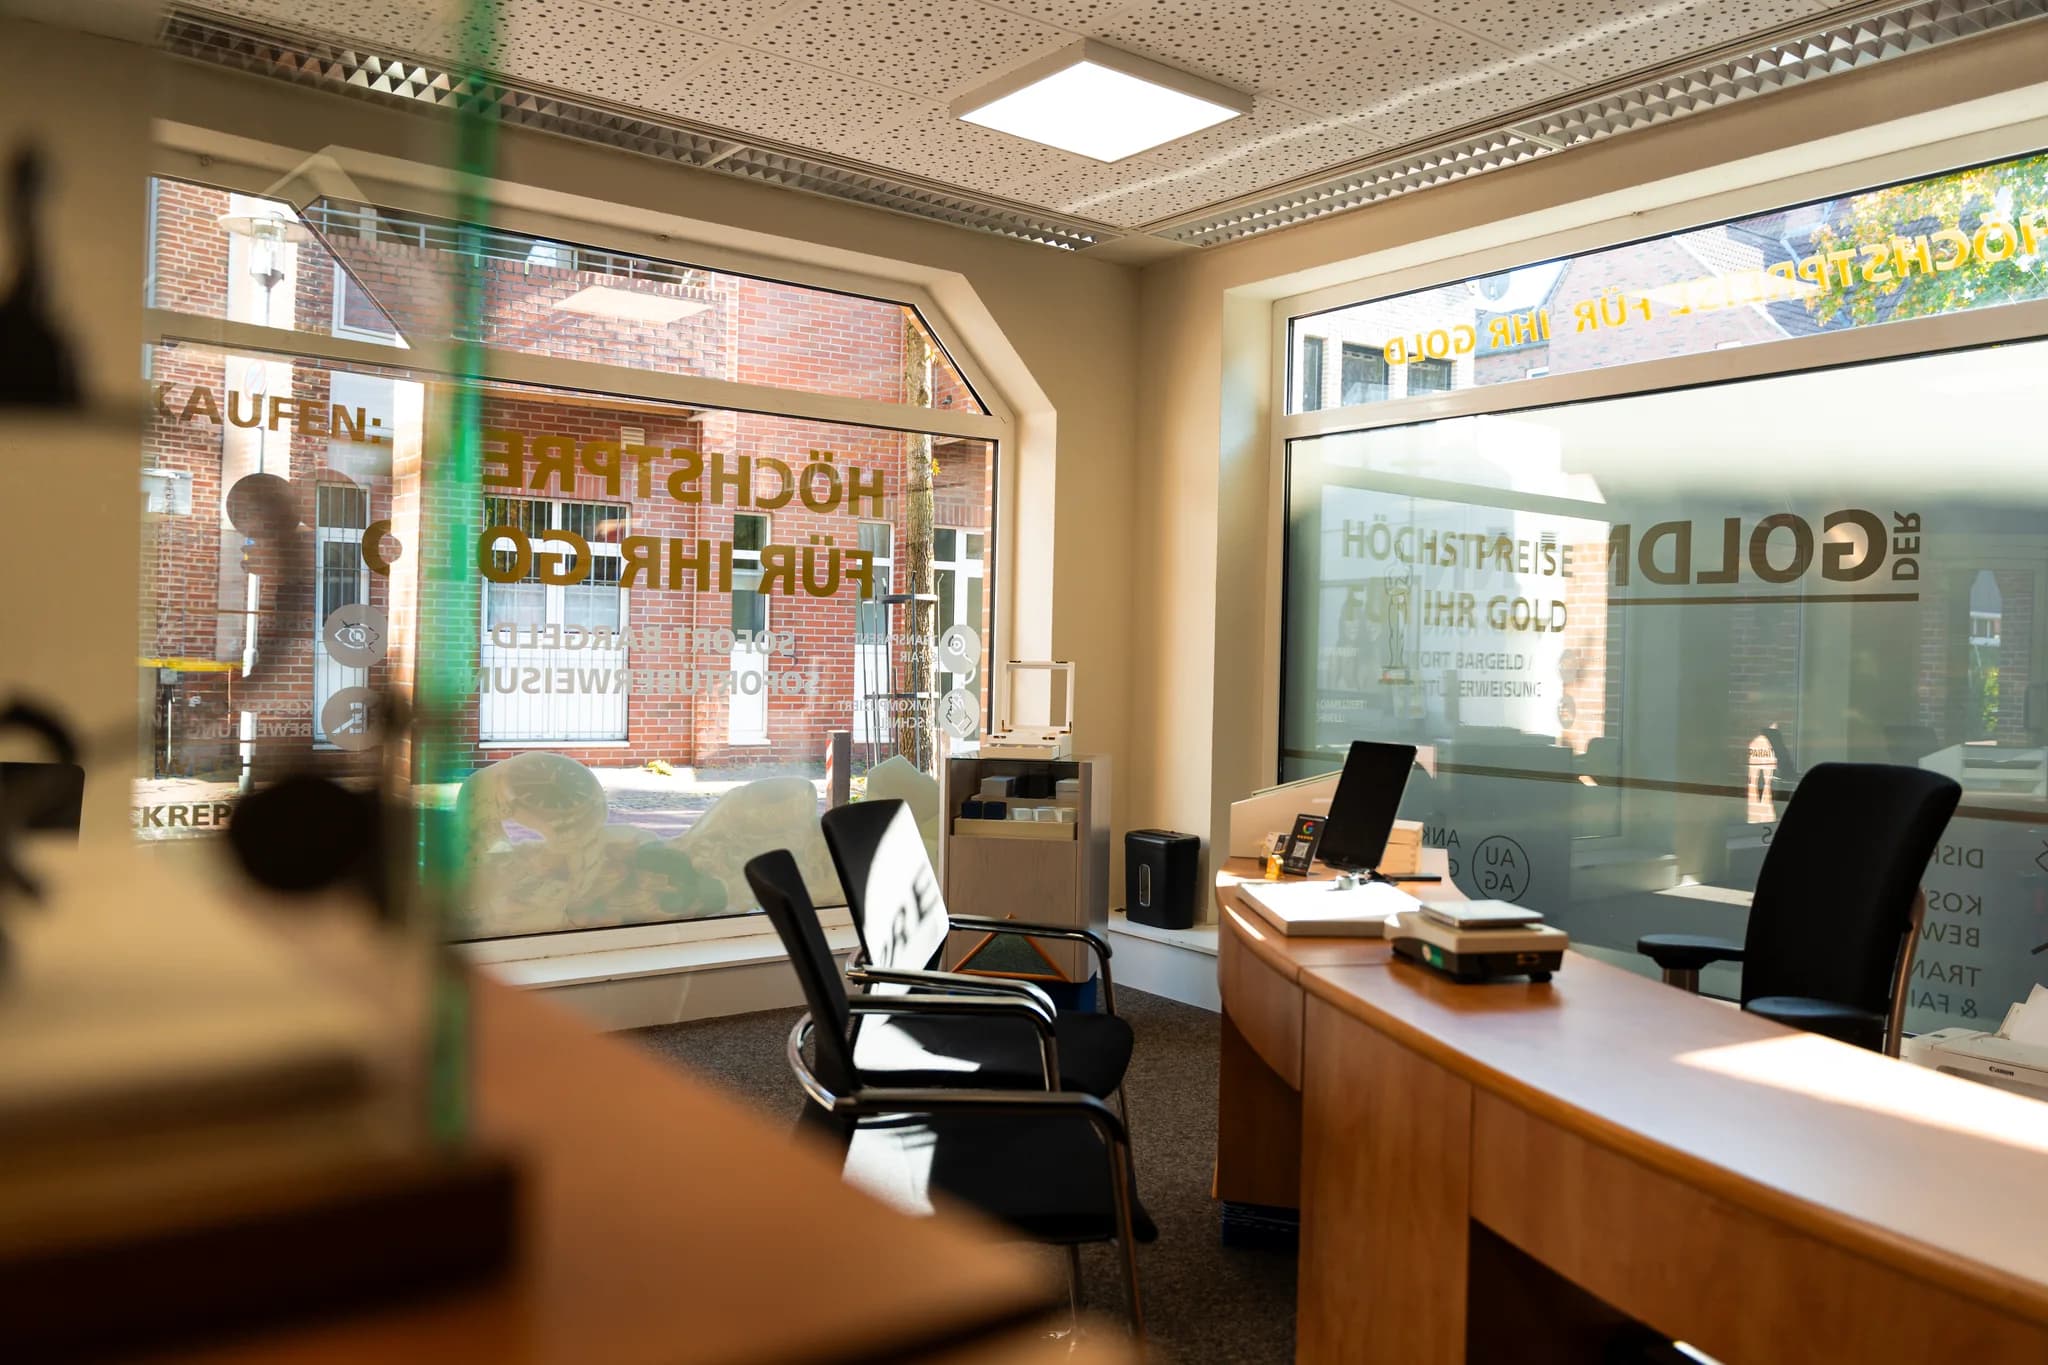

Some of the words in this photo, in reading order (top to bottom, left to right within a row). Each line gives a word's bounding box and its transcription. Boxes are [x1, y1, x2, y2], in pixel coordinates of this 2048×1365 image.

[1342, 514, 1573, 577] HÖCHSTPREISE
[1424, 590, 1477, 628] IHR
[1487, 595, 1568, 633] GOLD
[1456, 651, 1524, 671] BARGELD
[136, 804, 232, 828] KREP
[1989, 1065, 2015, 1077] Canon
